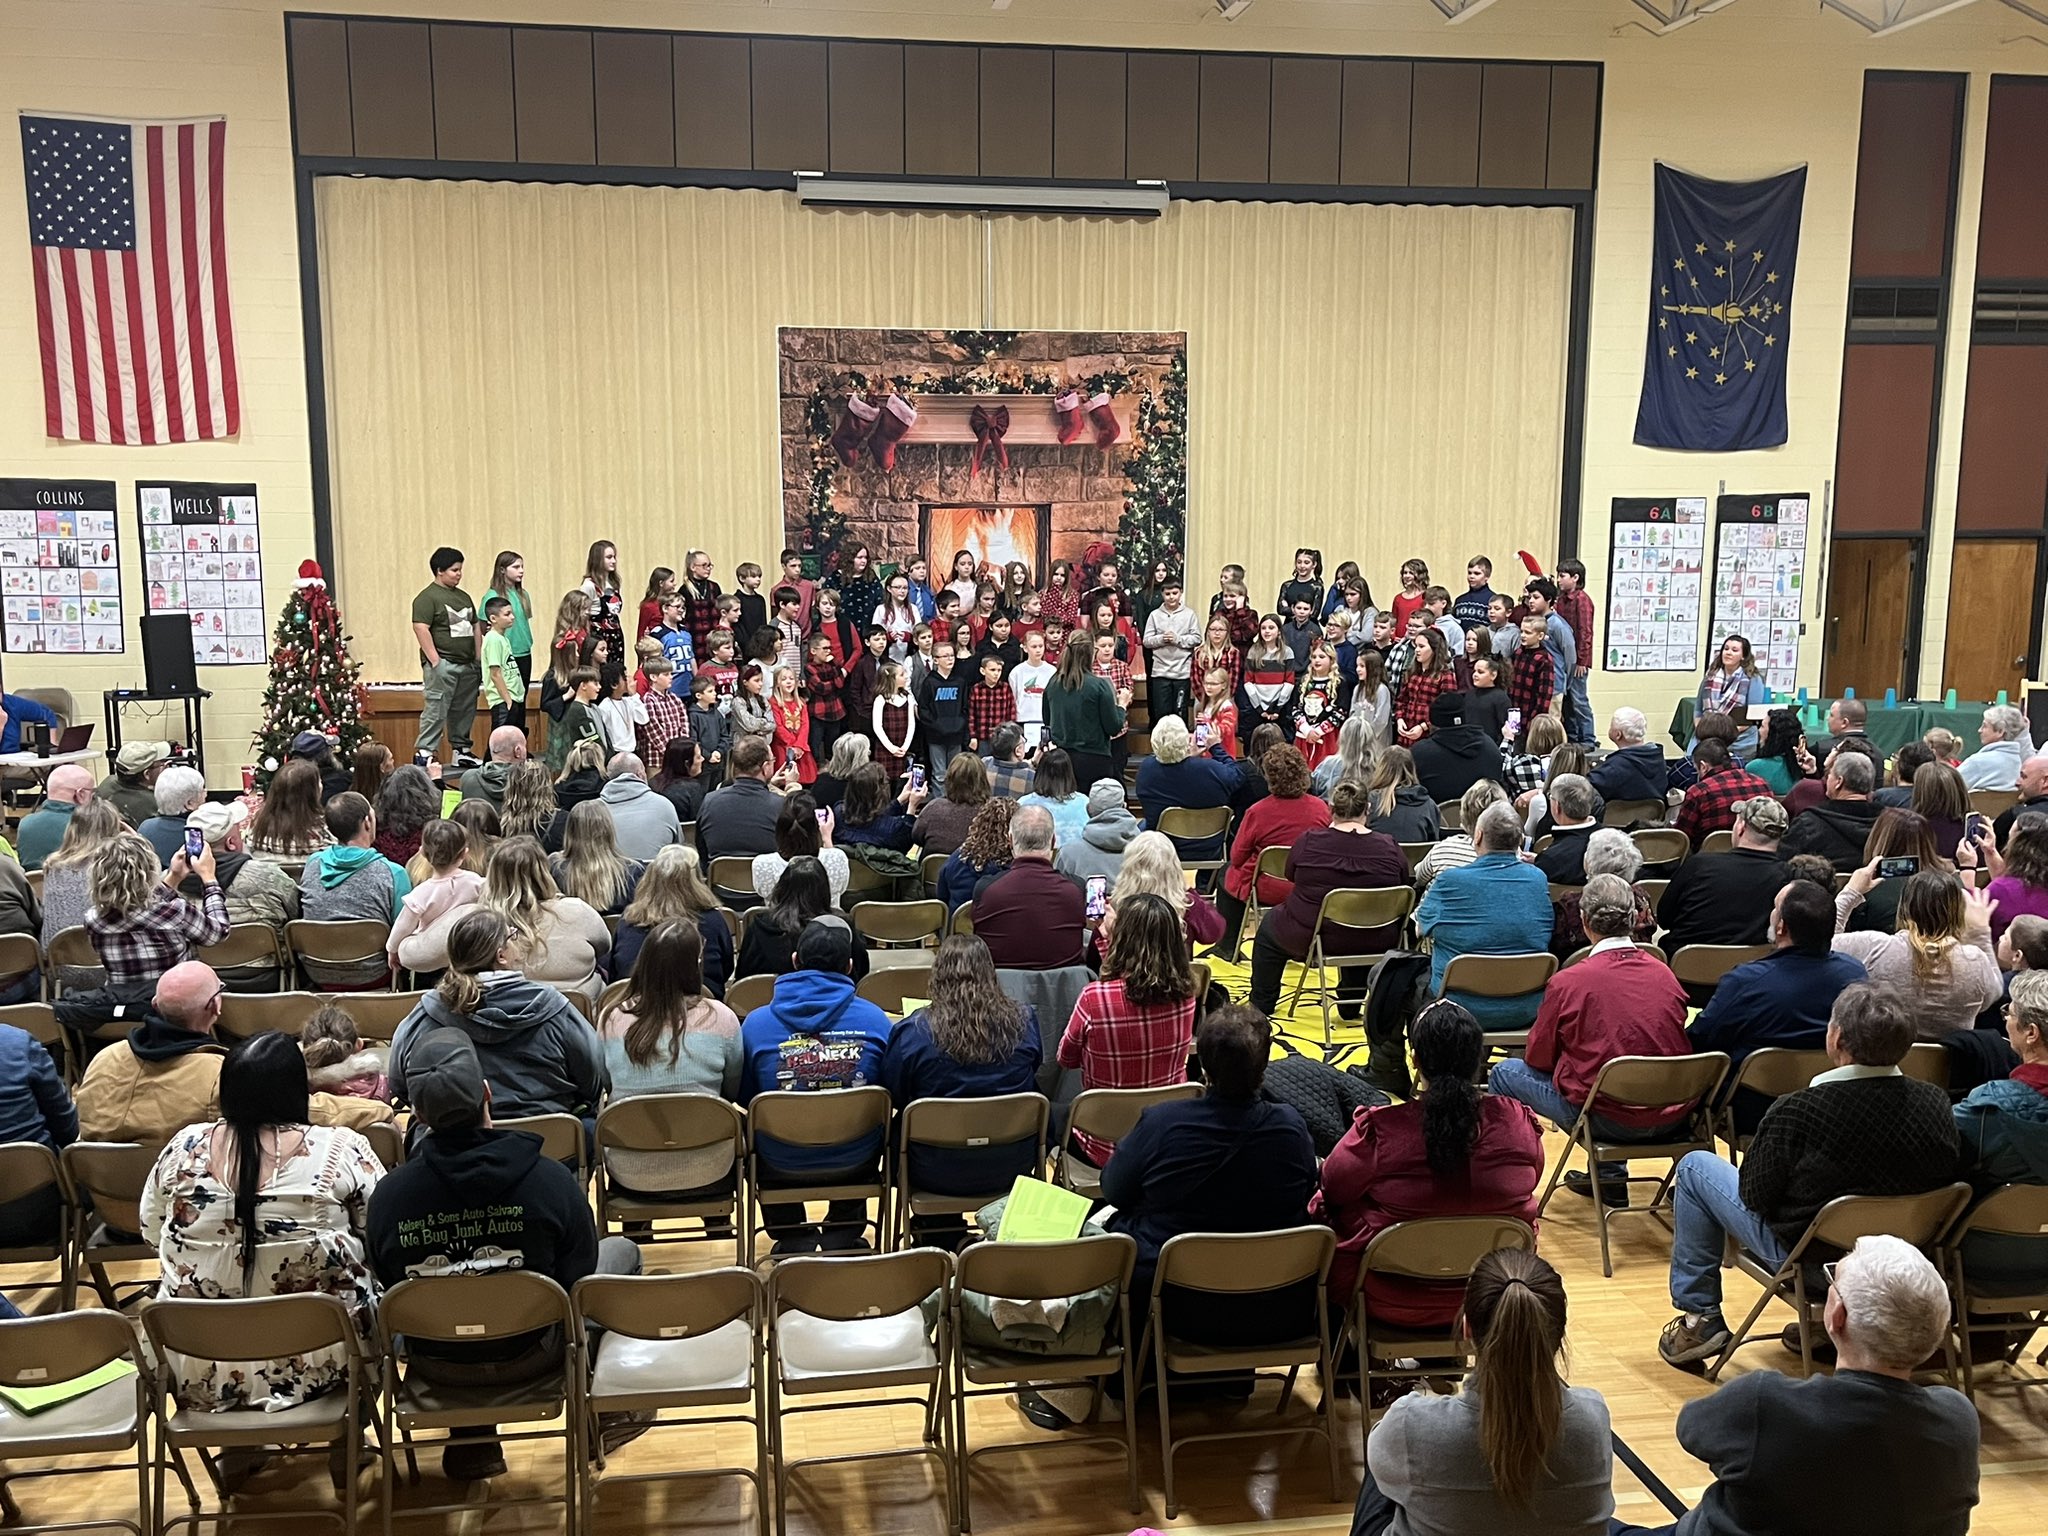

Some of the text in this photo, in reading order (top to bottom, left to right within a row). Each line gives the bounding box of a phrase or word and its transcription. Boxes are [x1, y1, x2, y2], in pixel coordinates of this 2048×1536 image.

[36, 490, 84, 506] COLLINS
[173, 498, 213, 515] WELLS
[1649, 506, 1671, 520] 6A
[1751, 504, 1774, 518] 6B
[935, 687, 958, 701] NIKE
[398, 1205, 523, 1234] Kelsey & Sons Auto Salvage
[400, 1218, 524, 1248] We Buy Junk Autos
